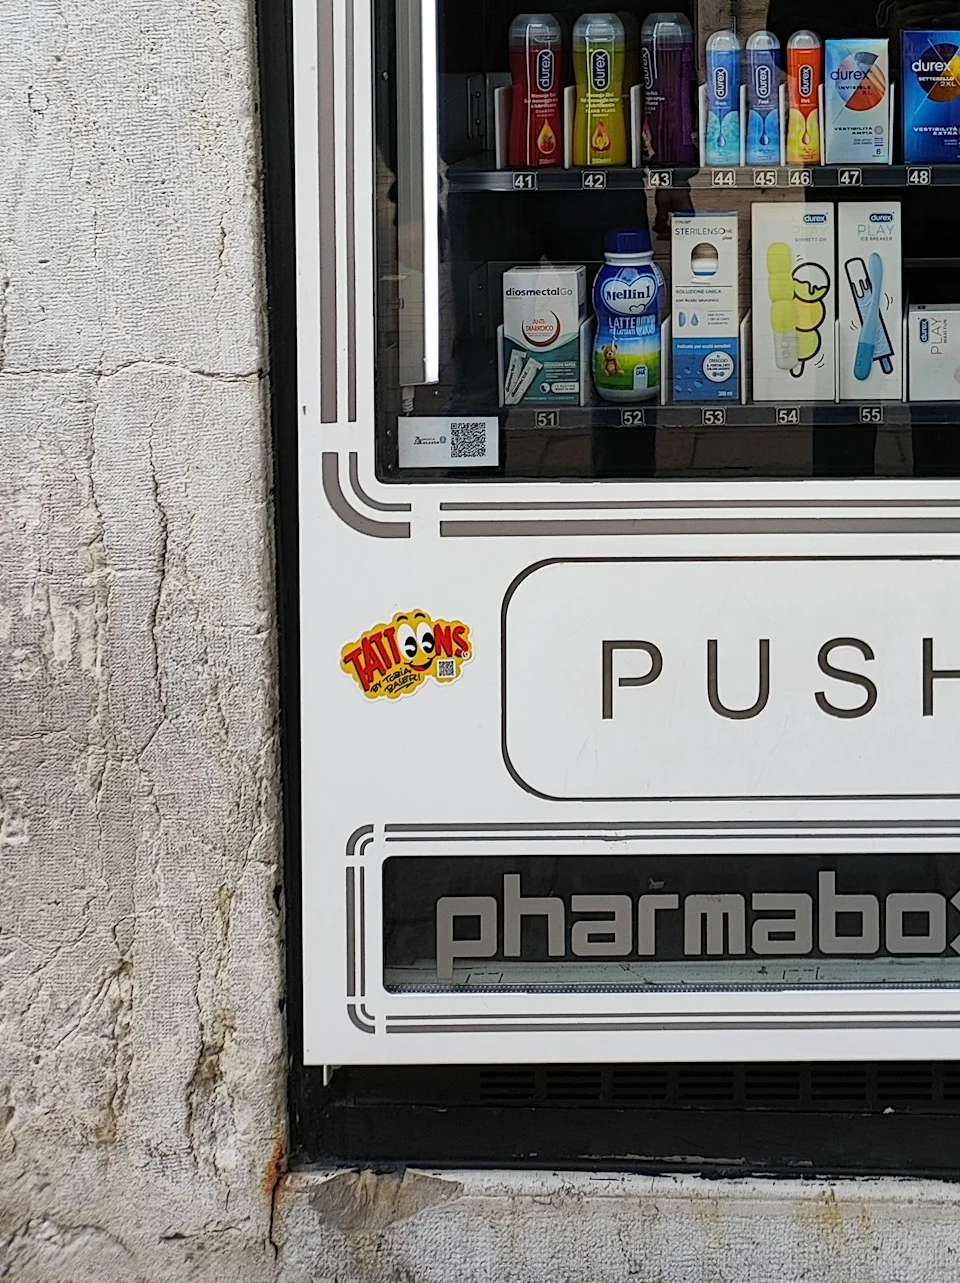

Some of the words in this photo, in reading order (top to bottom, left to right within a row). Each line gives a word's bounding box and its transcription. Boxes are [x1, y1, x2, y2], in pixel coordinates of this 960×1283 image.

[539, 54, 552, 89] durex
[593, 54, 608, 89] durex
[911, 58, 952, 72] durex
[758, 68, 768, 95] durex
[801, 67, 810, 94] durex
[830, 68, 871, 81] durex
[716, 69, 725, 97] durex
[939, 80, 957, 88] 2XL
[803, 214, 826, 223] durex
[870, 214, 892, 222] durex
[857, 224, 895, 237] PLAY
[505, 287, 573, 297] diosmectalGo
[525, 324, 554, 332] DIARROICO
[609, 316, 636, 329] LATTE
[930, 317, 942, 356] PLAY
[537, 411, 556, 426] 51
[623, 411, 642, 425] 52
[704, 410, 723, 425] 53
[779, 409, 798, 424] 54
[862, 407, 881, 422] 55
[370, 682, 382, 694] BY
[382, 667, 412, 684] TOBIA
